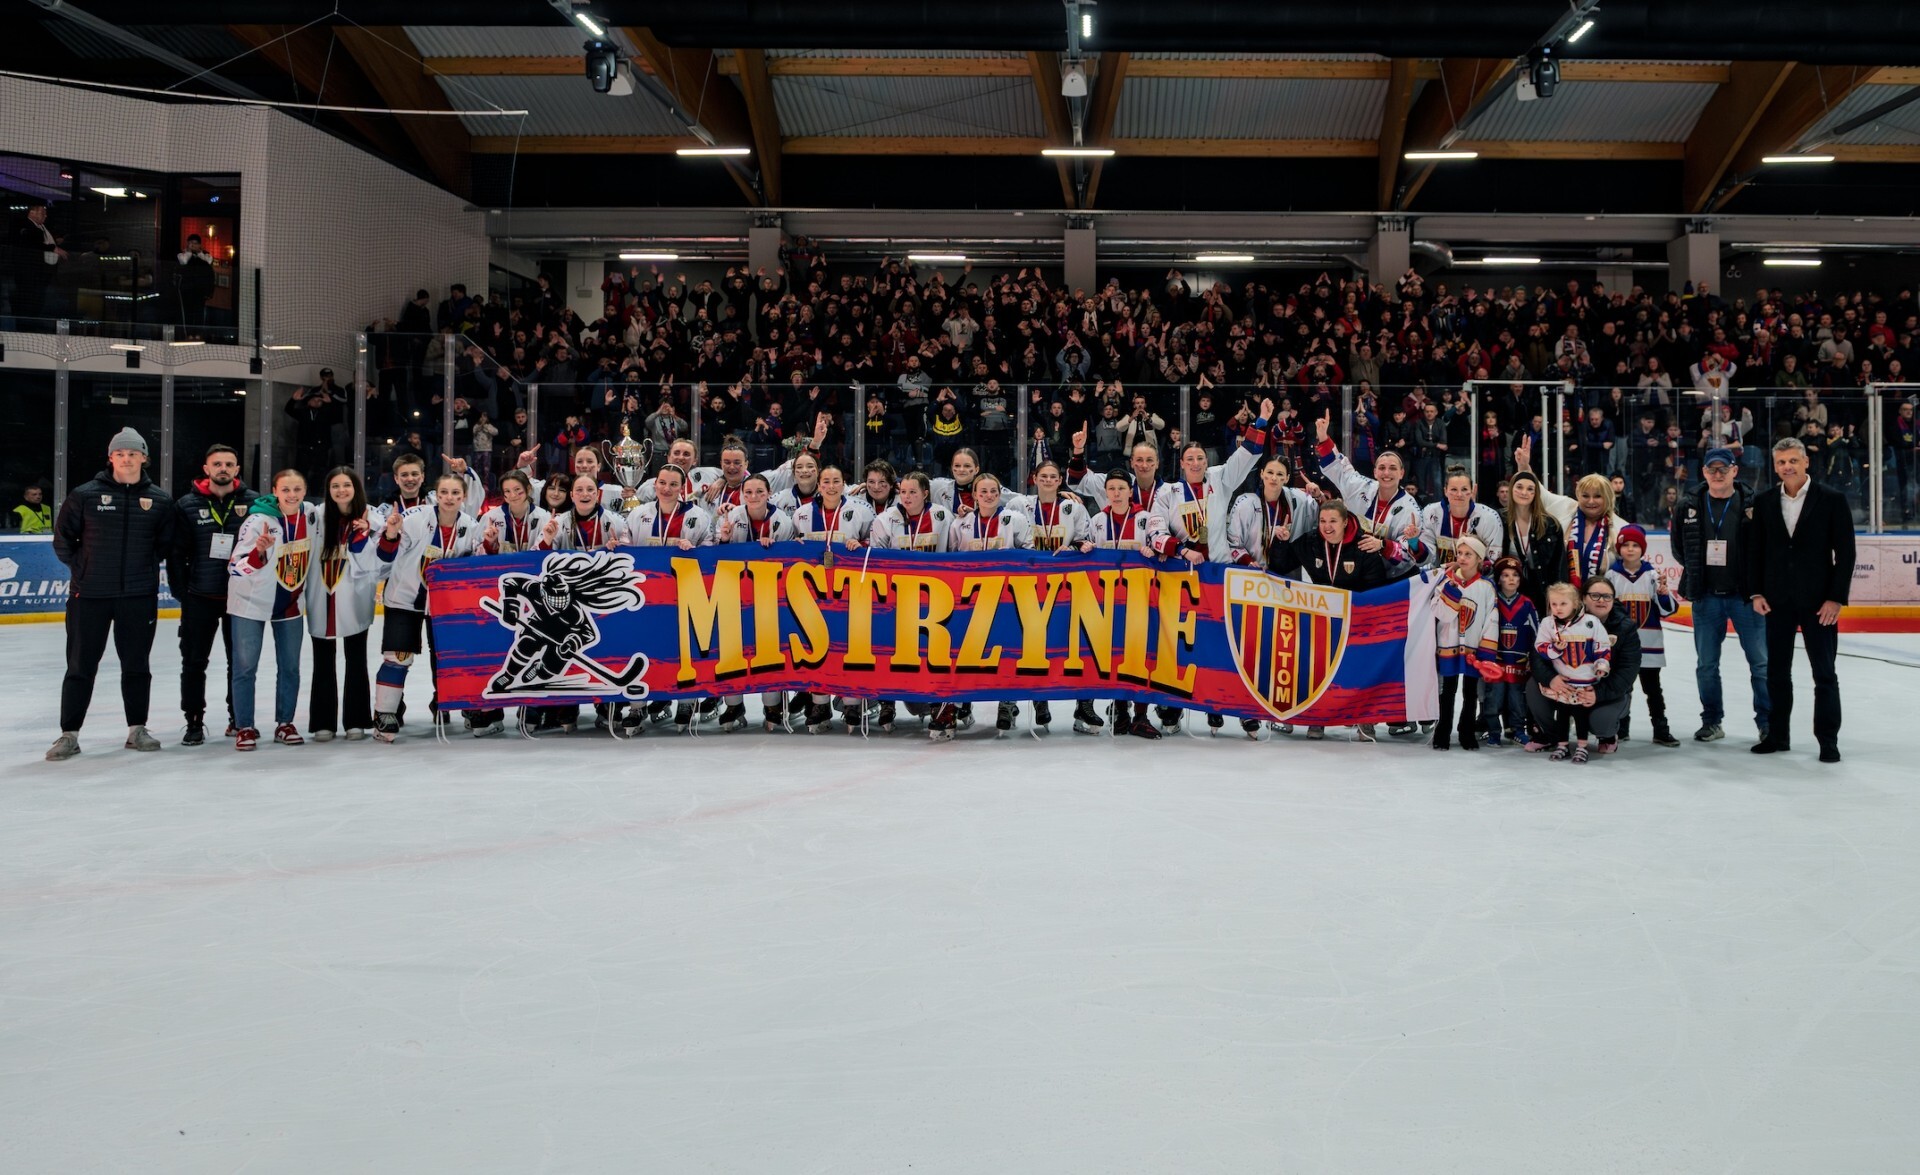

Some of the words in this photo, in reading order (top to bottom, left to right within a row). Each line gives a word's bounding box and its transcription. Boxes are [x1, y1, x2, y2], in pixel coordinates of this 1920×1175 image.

[671, 557, 1200, 698] MISTRZYNIE
[1243, 579, 1329, 610] POLONIA
[1275, 613, 1294, 704] BYTOM
